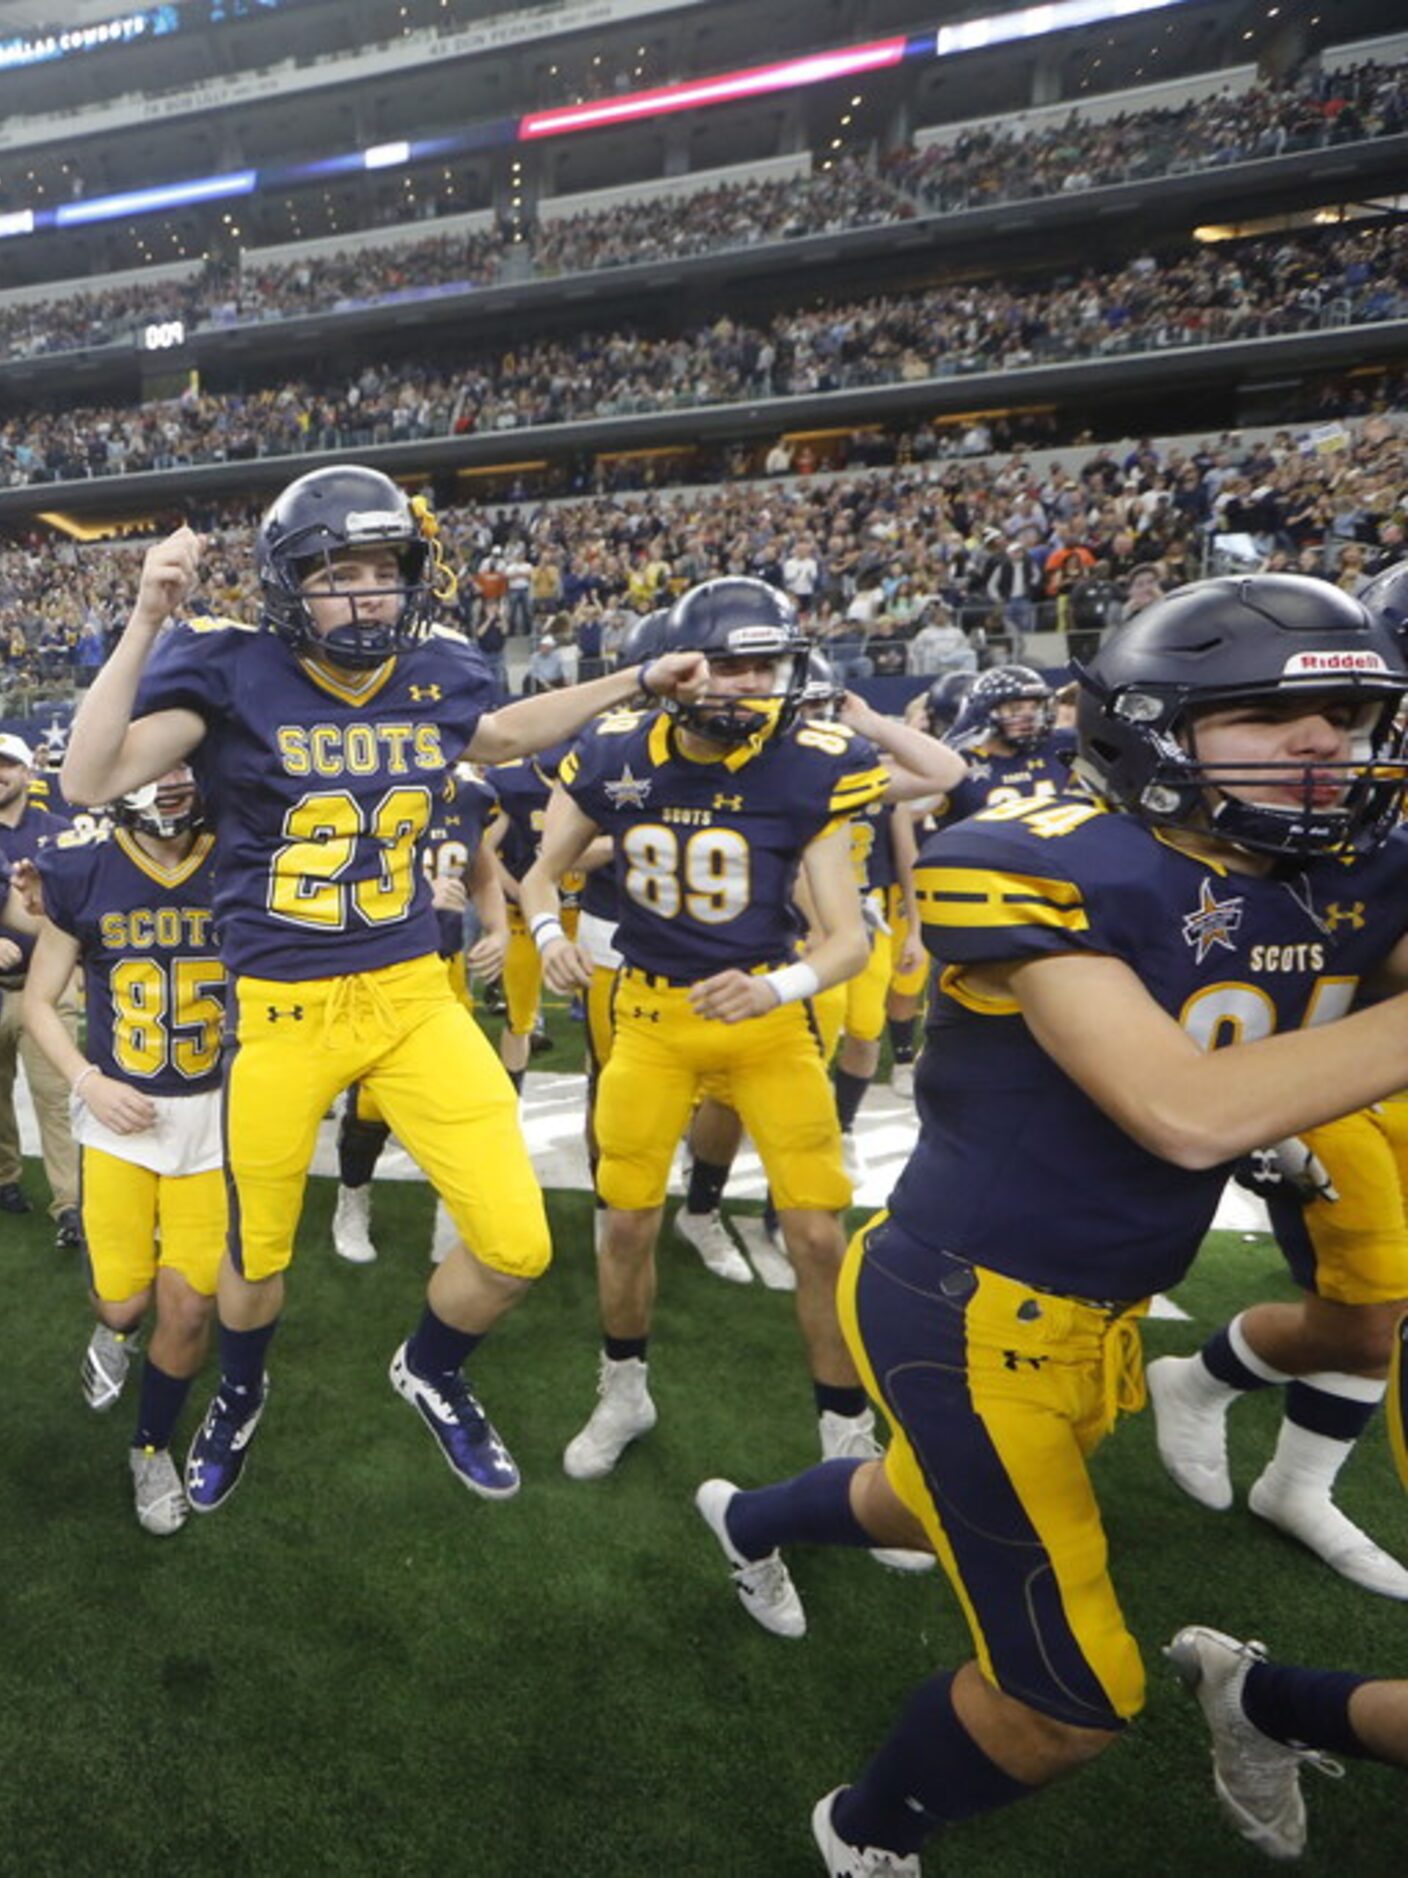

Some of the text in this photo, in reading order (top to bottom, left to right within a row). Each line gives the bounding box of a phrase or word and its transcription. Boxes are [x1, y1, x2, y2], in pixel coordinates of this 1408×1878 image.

[59, 16, 145, 50] COWBOYS
[1300, 655, 1378, 669] Riddell
[277, 723, 446, 777] SCOTS
[662, 808, 712, 826] SCOTS
[267, 785, 432, 931] 23
[623, 823, 750, 924] 89
[100, 905, 220, 949] SCOT
[1249, 942, 1326, 973] SCOTS
[110, 955, 229, 1081] 85
